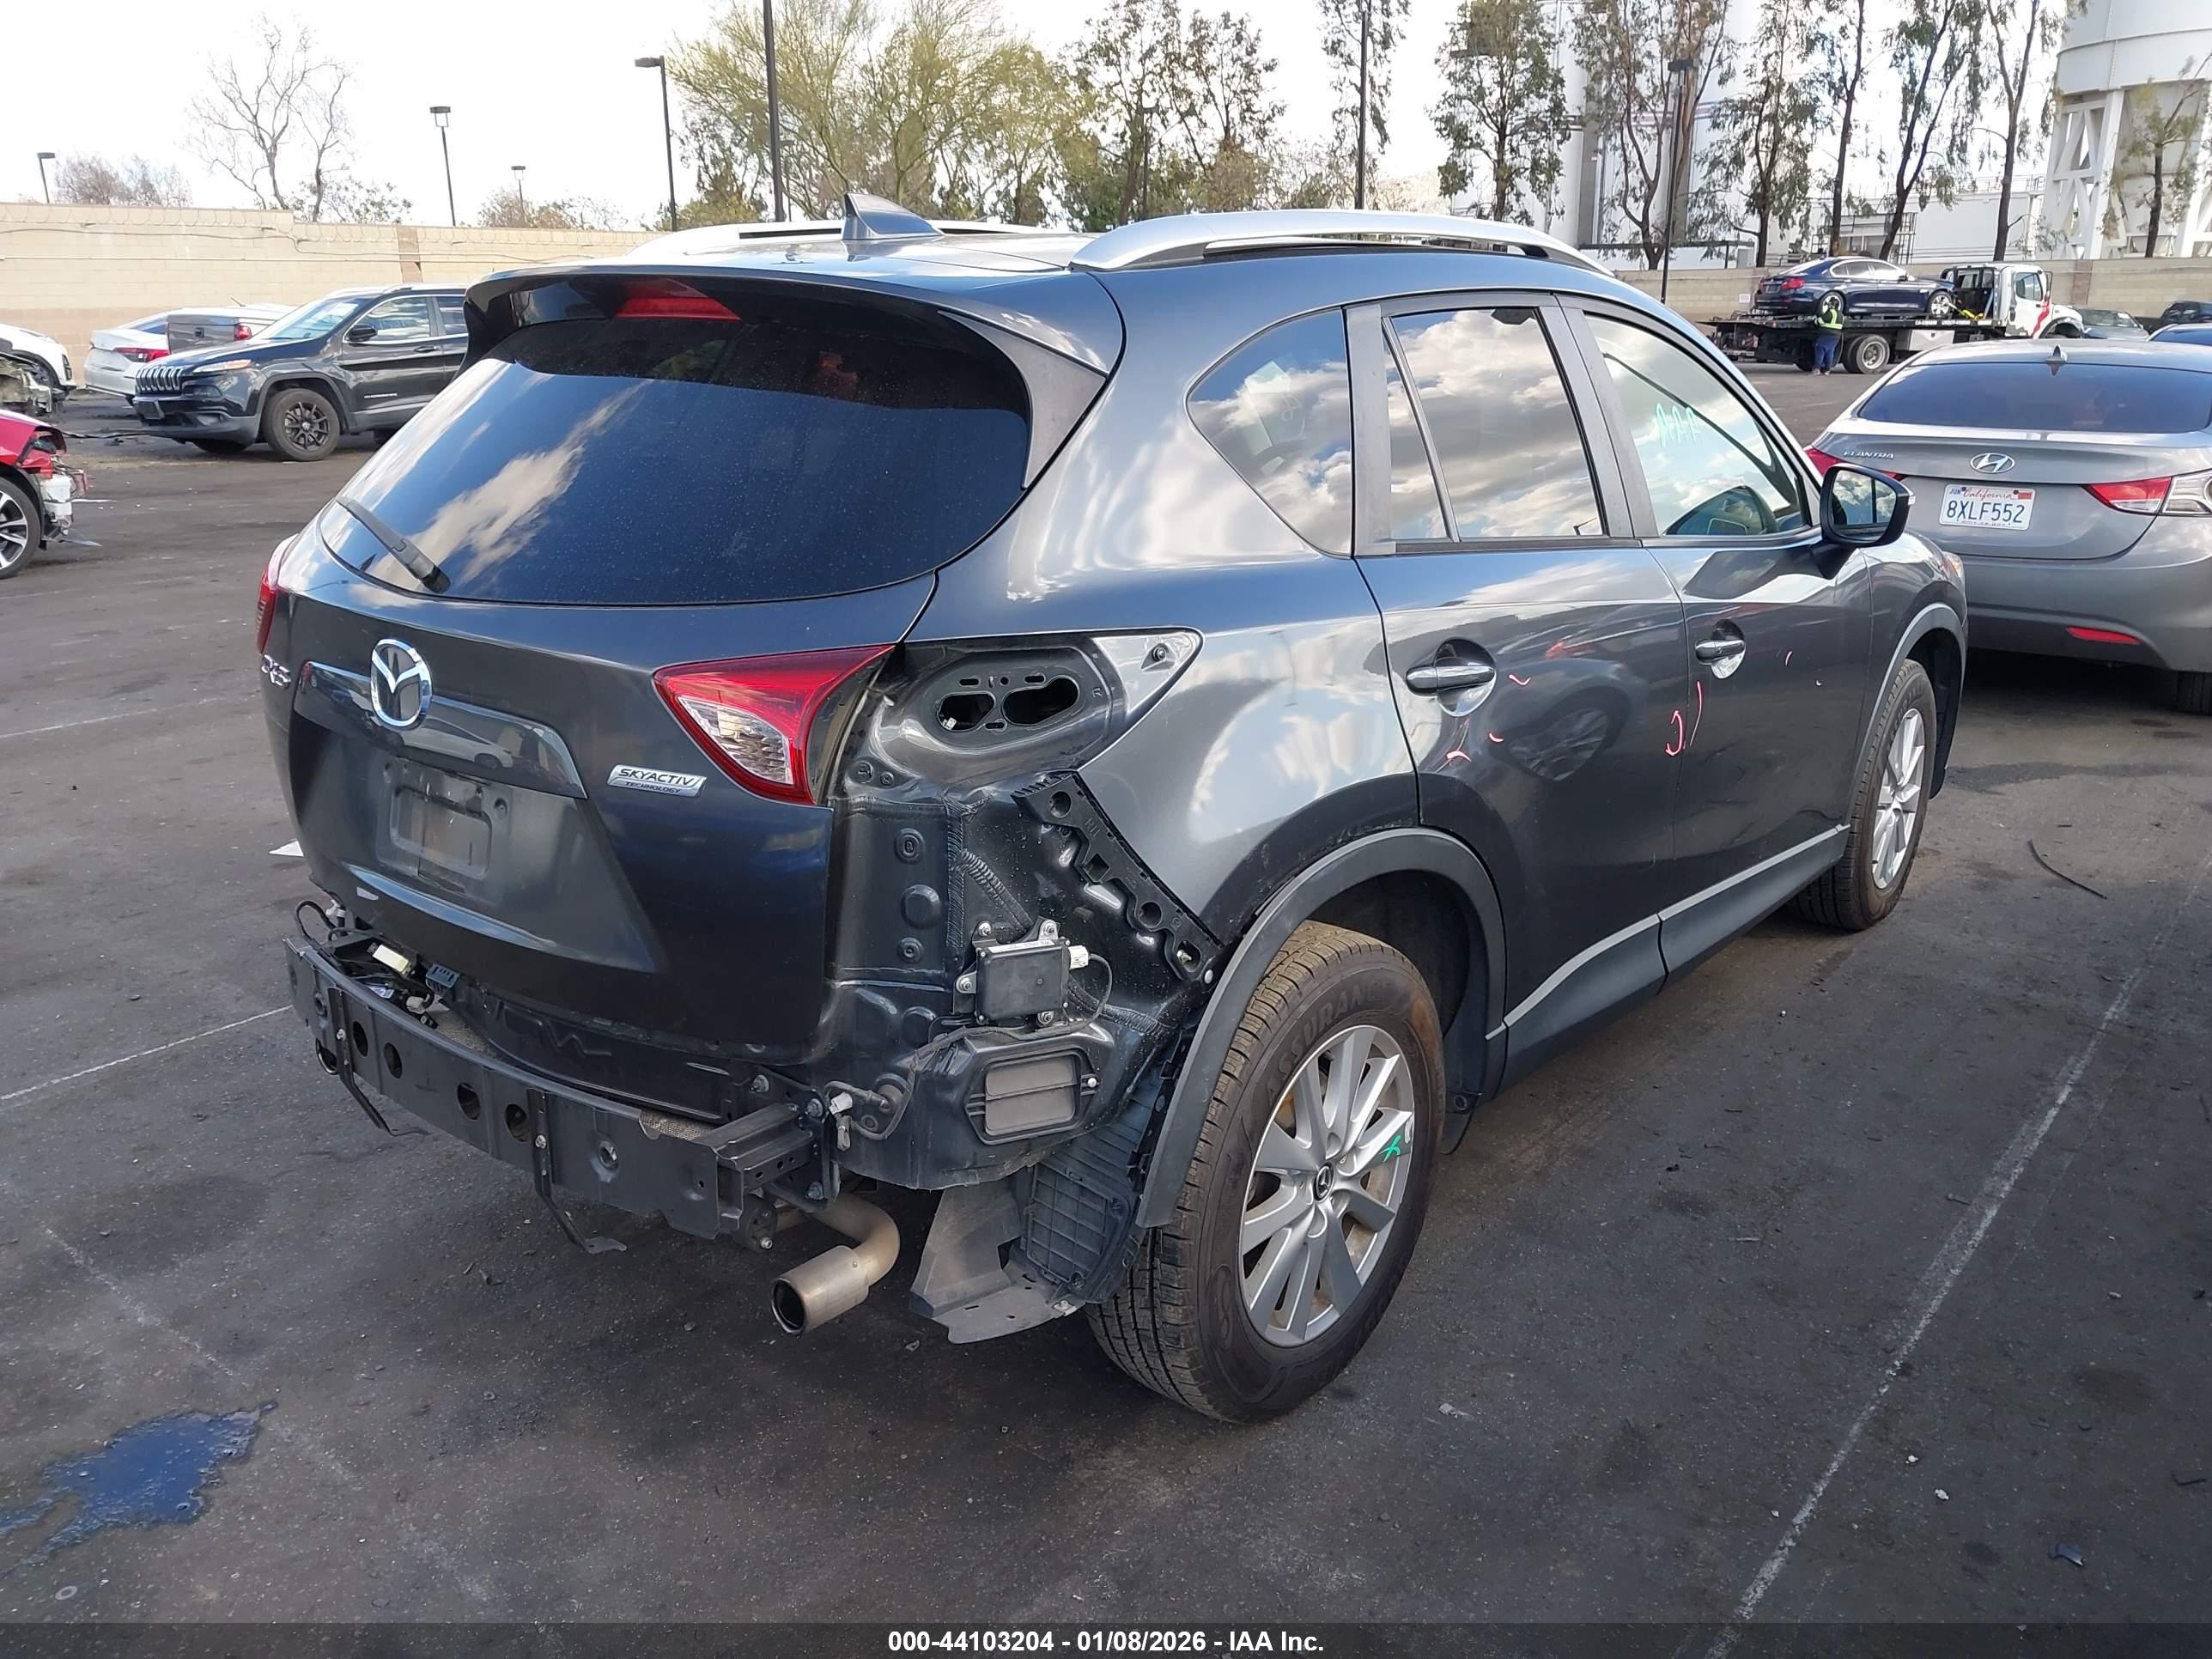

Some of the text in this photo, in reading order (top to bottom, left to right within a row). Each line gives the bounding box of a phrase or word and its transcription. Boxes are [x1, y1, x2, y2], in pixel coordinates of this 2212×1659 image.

[1963, 488, 2016, 501] California
[1946, 500, 2026, 524] 8XLF552
[618, 769, 694, 786] SKYACTIV
[625, 781, 681, 793] TECHNOLOGY
